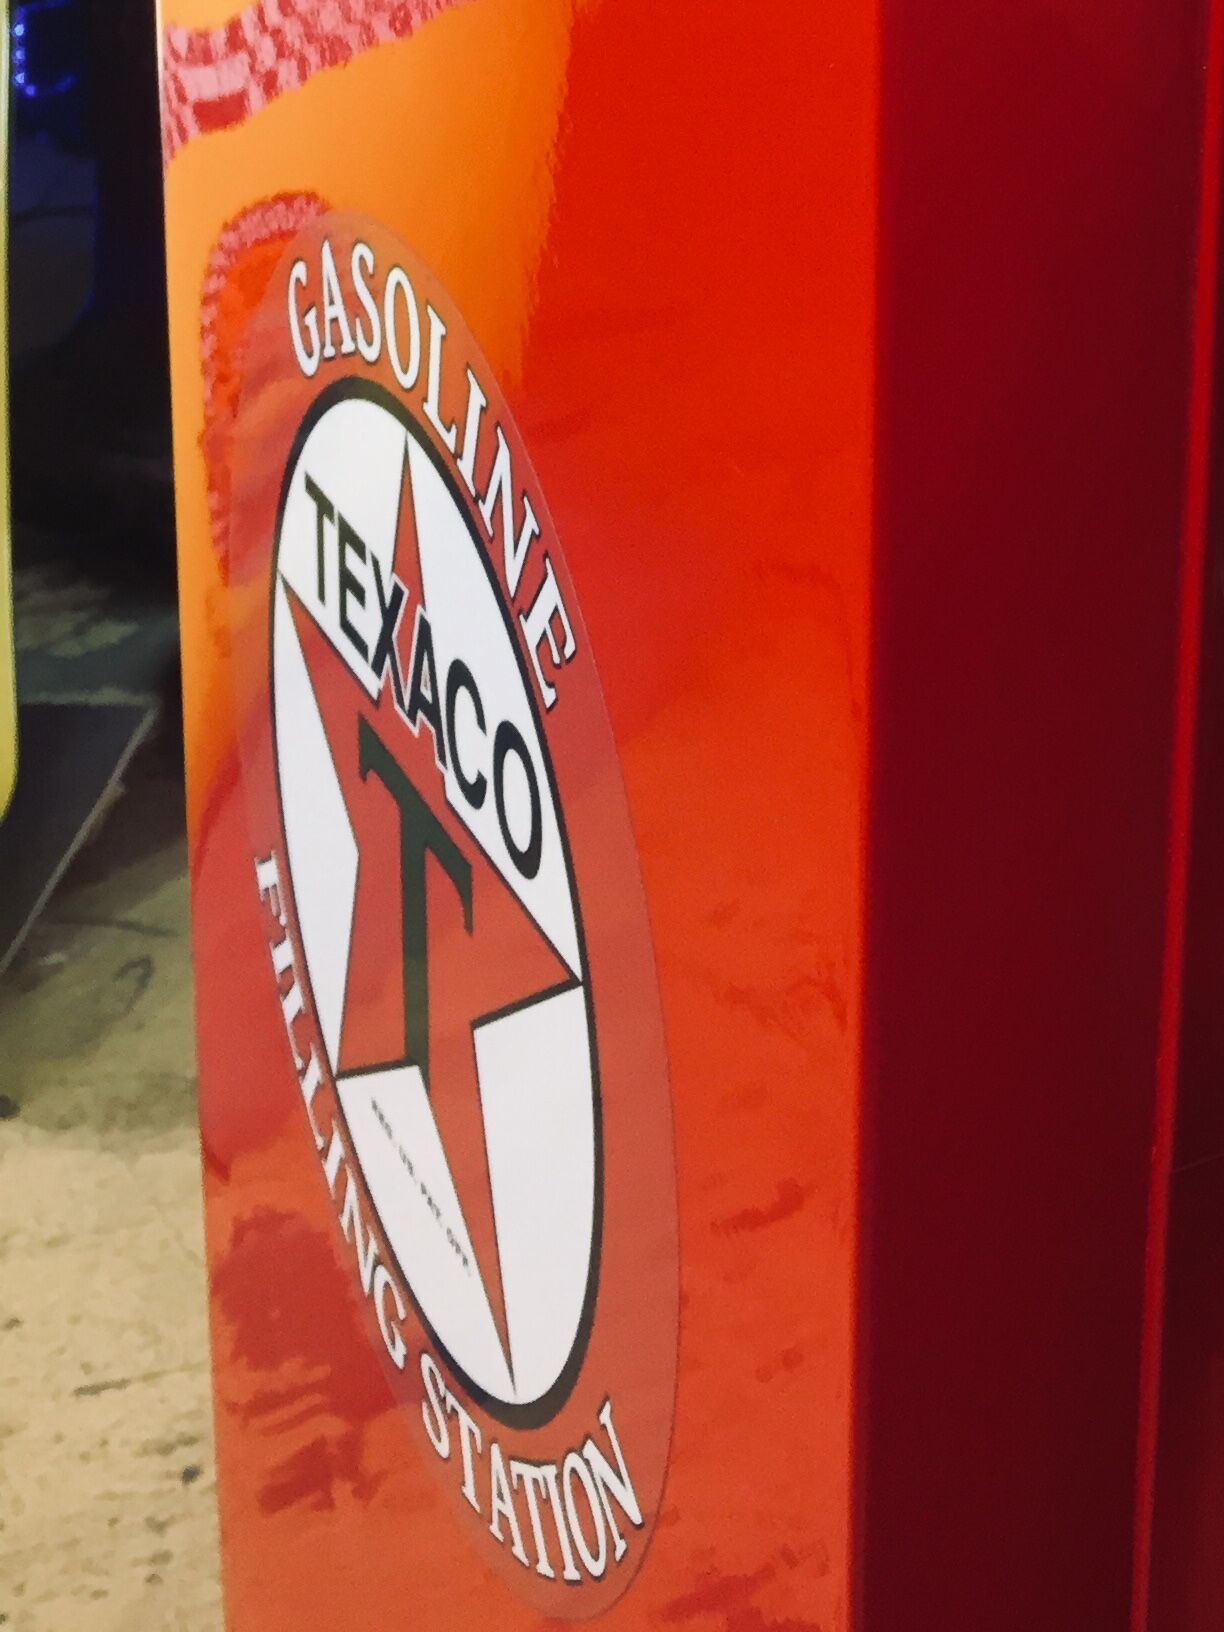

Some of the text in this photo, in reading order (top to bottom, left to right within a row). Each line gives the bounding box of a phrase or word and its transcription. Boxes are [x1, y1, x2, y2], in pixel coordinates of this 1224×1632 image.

[288, 238, 577, 711] GASOLINE
[303, 470, 543, 880] TEXACO
[253, 848, 408, 1371] FILLING
[419, 1351, 645, 1584] STATION
